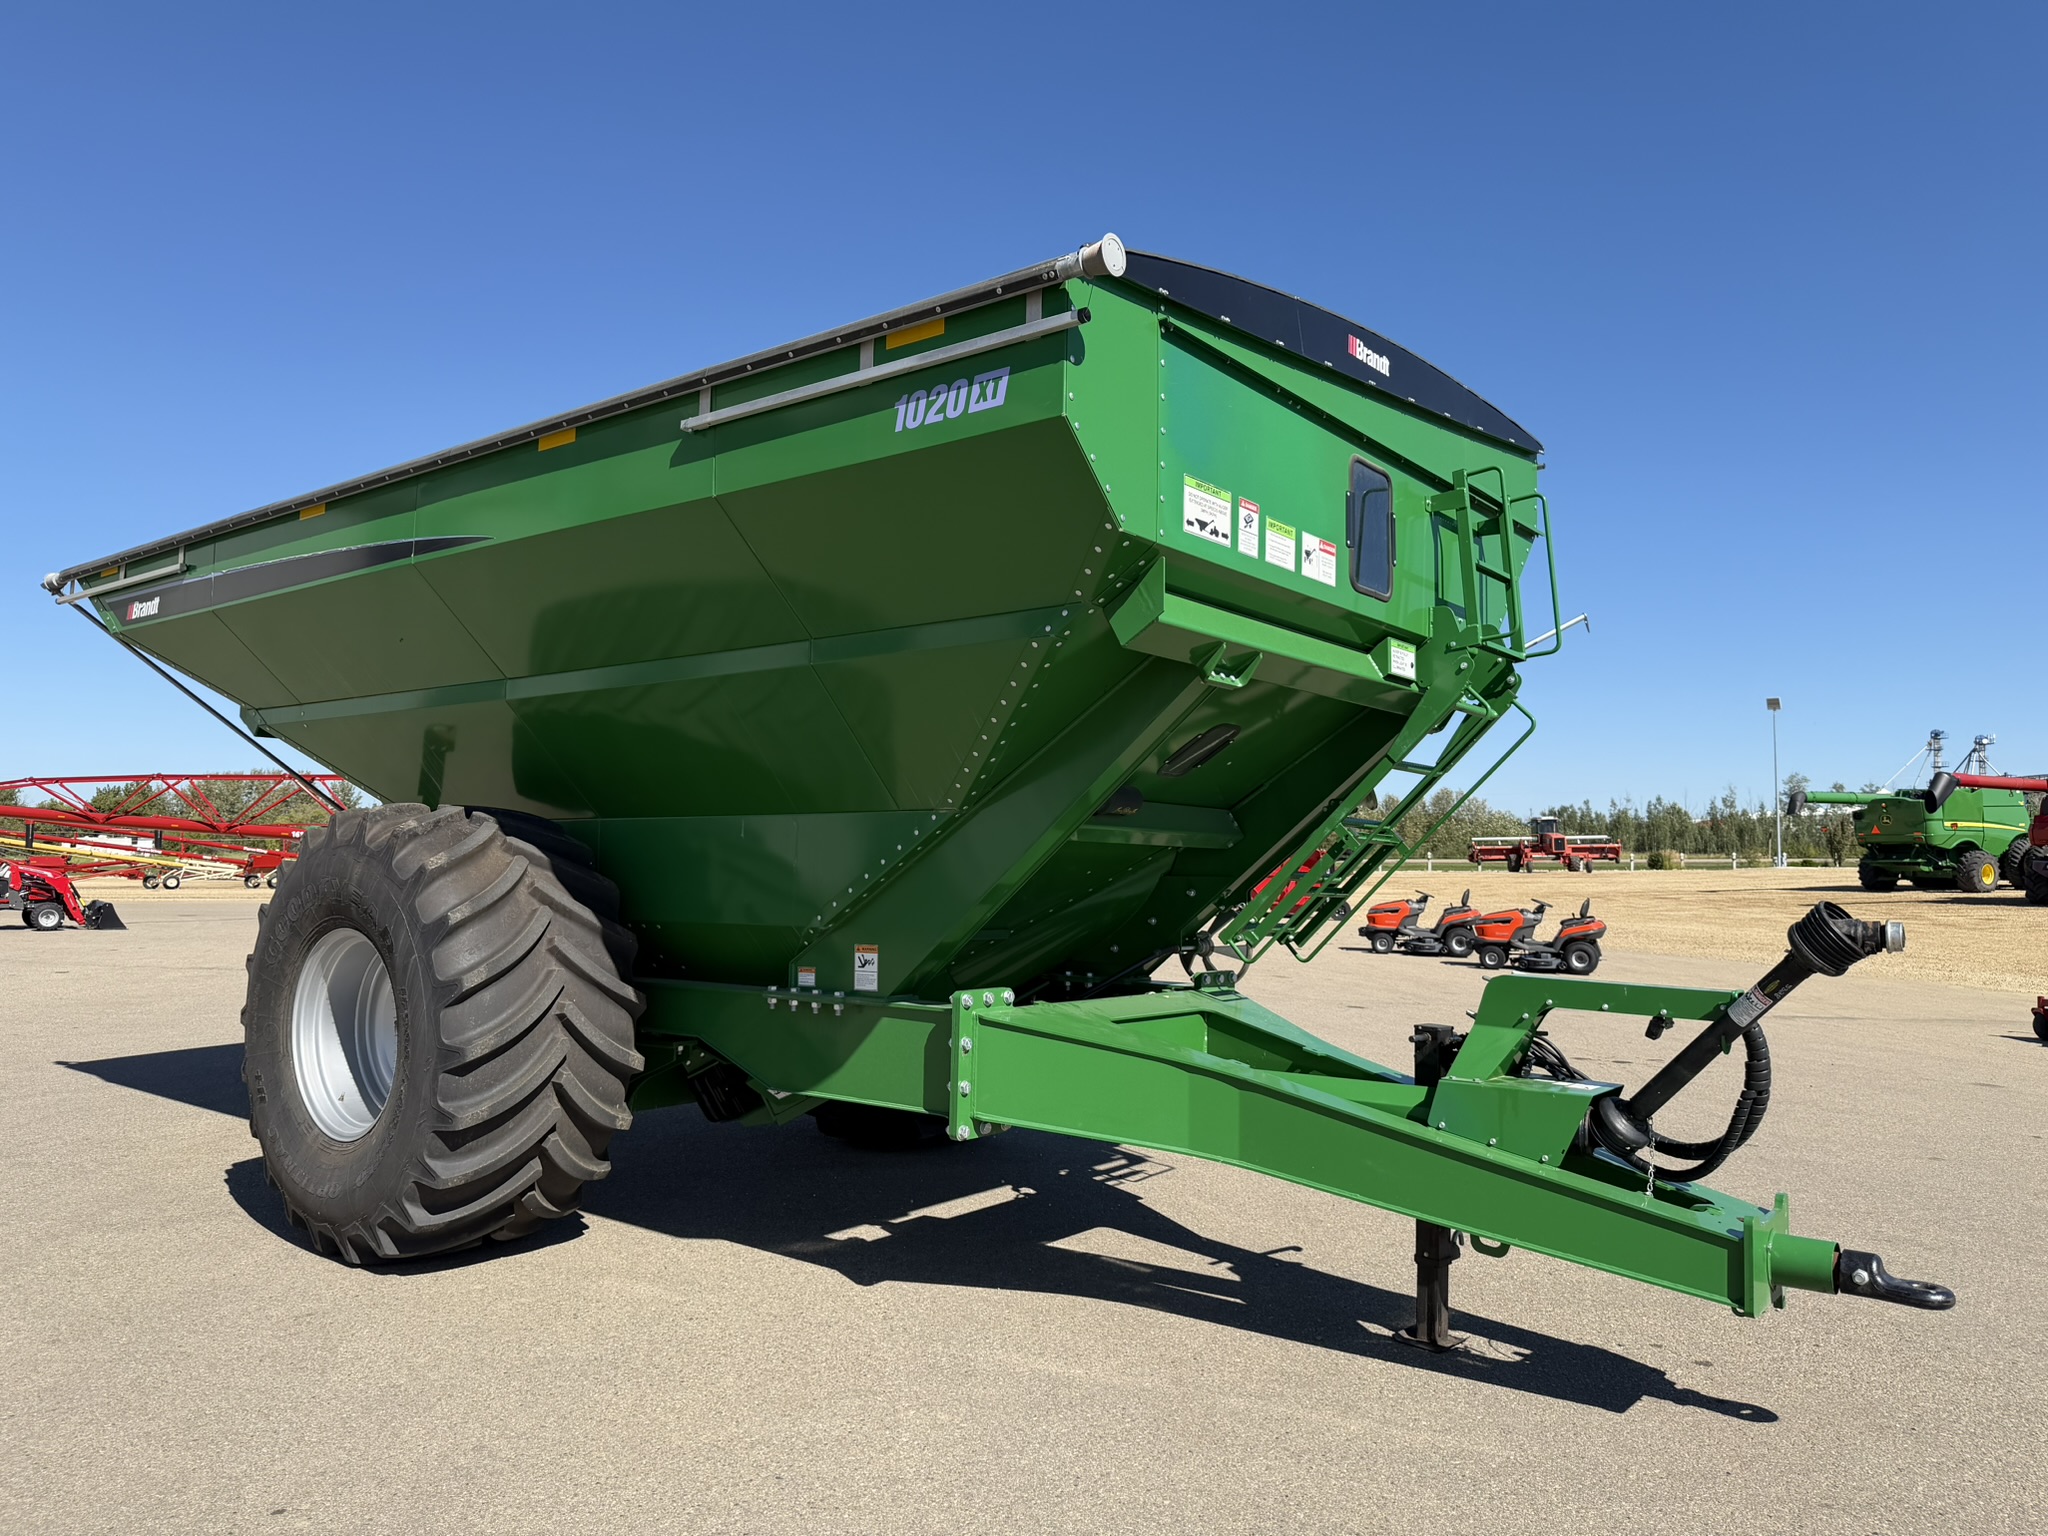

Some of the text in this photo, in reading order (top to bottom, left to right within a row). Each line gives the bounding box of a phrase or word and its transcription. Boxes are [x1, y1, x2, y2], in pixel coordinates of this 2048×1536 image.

[1356, 338, 1390, 377] Brandt
[894, 378, 969, 433] 1020
[1195, 481, 1222, 497] IMPORTANT
[1268, 521, 1294, 537] IMPORTANT
[132, 596, 160, 619] Brandt
